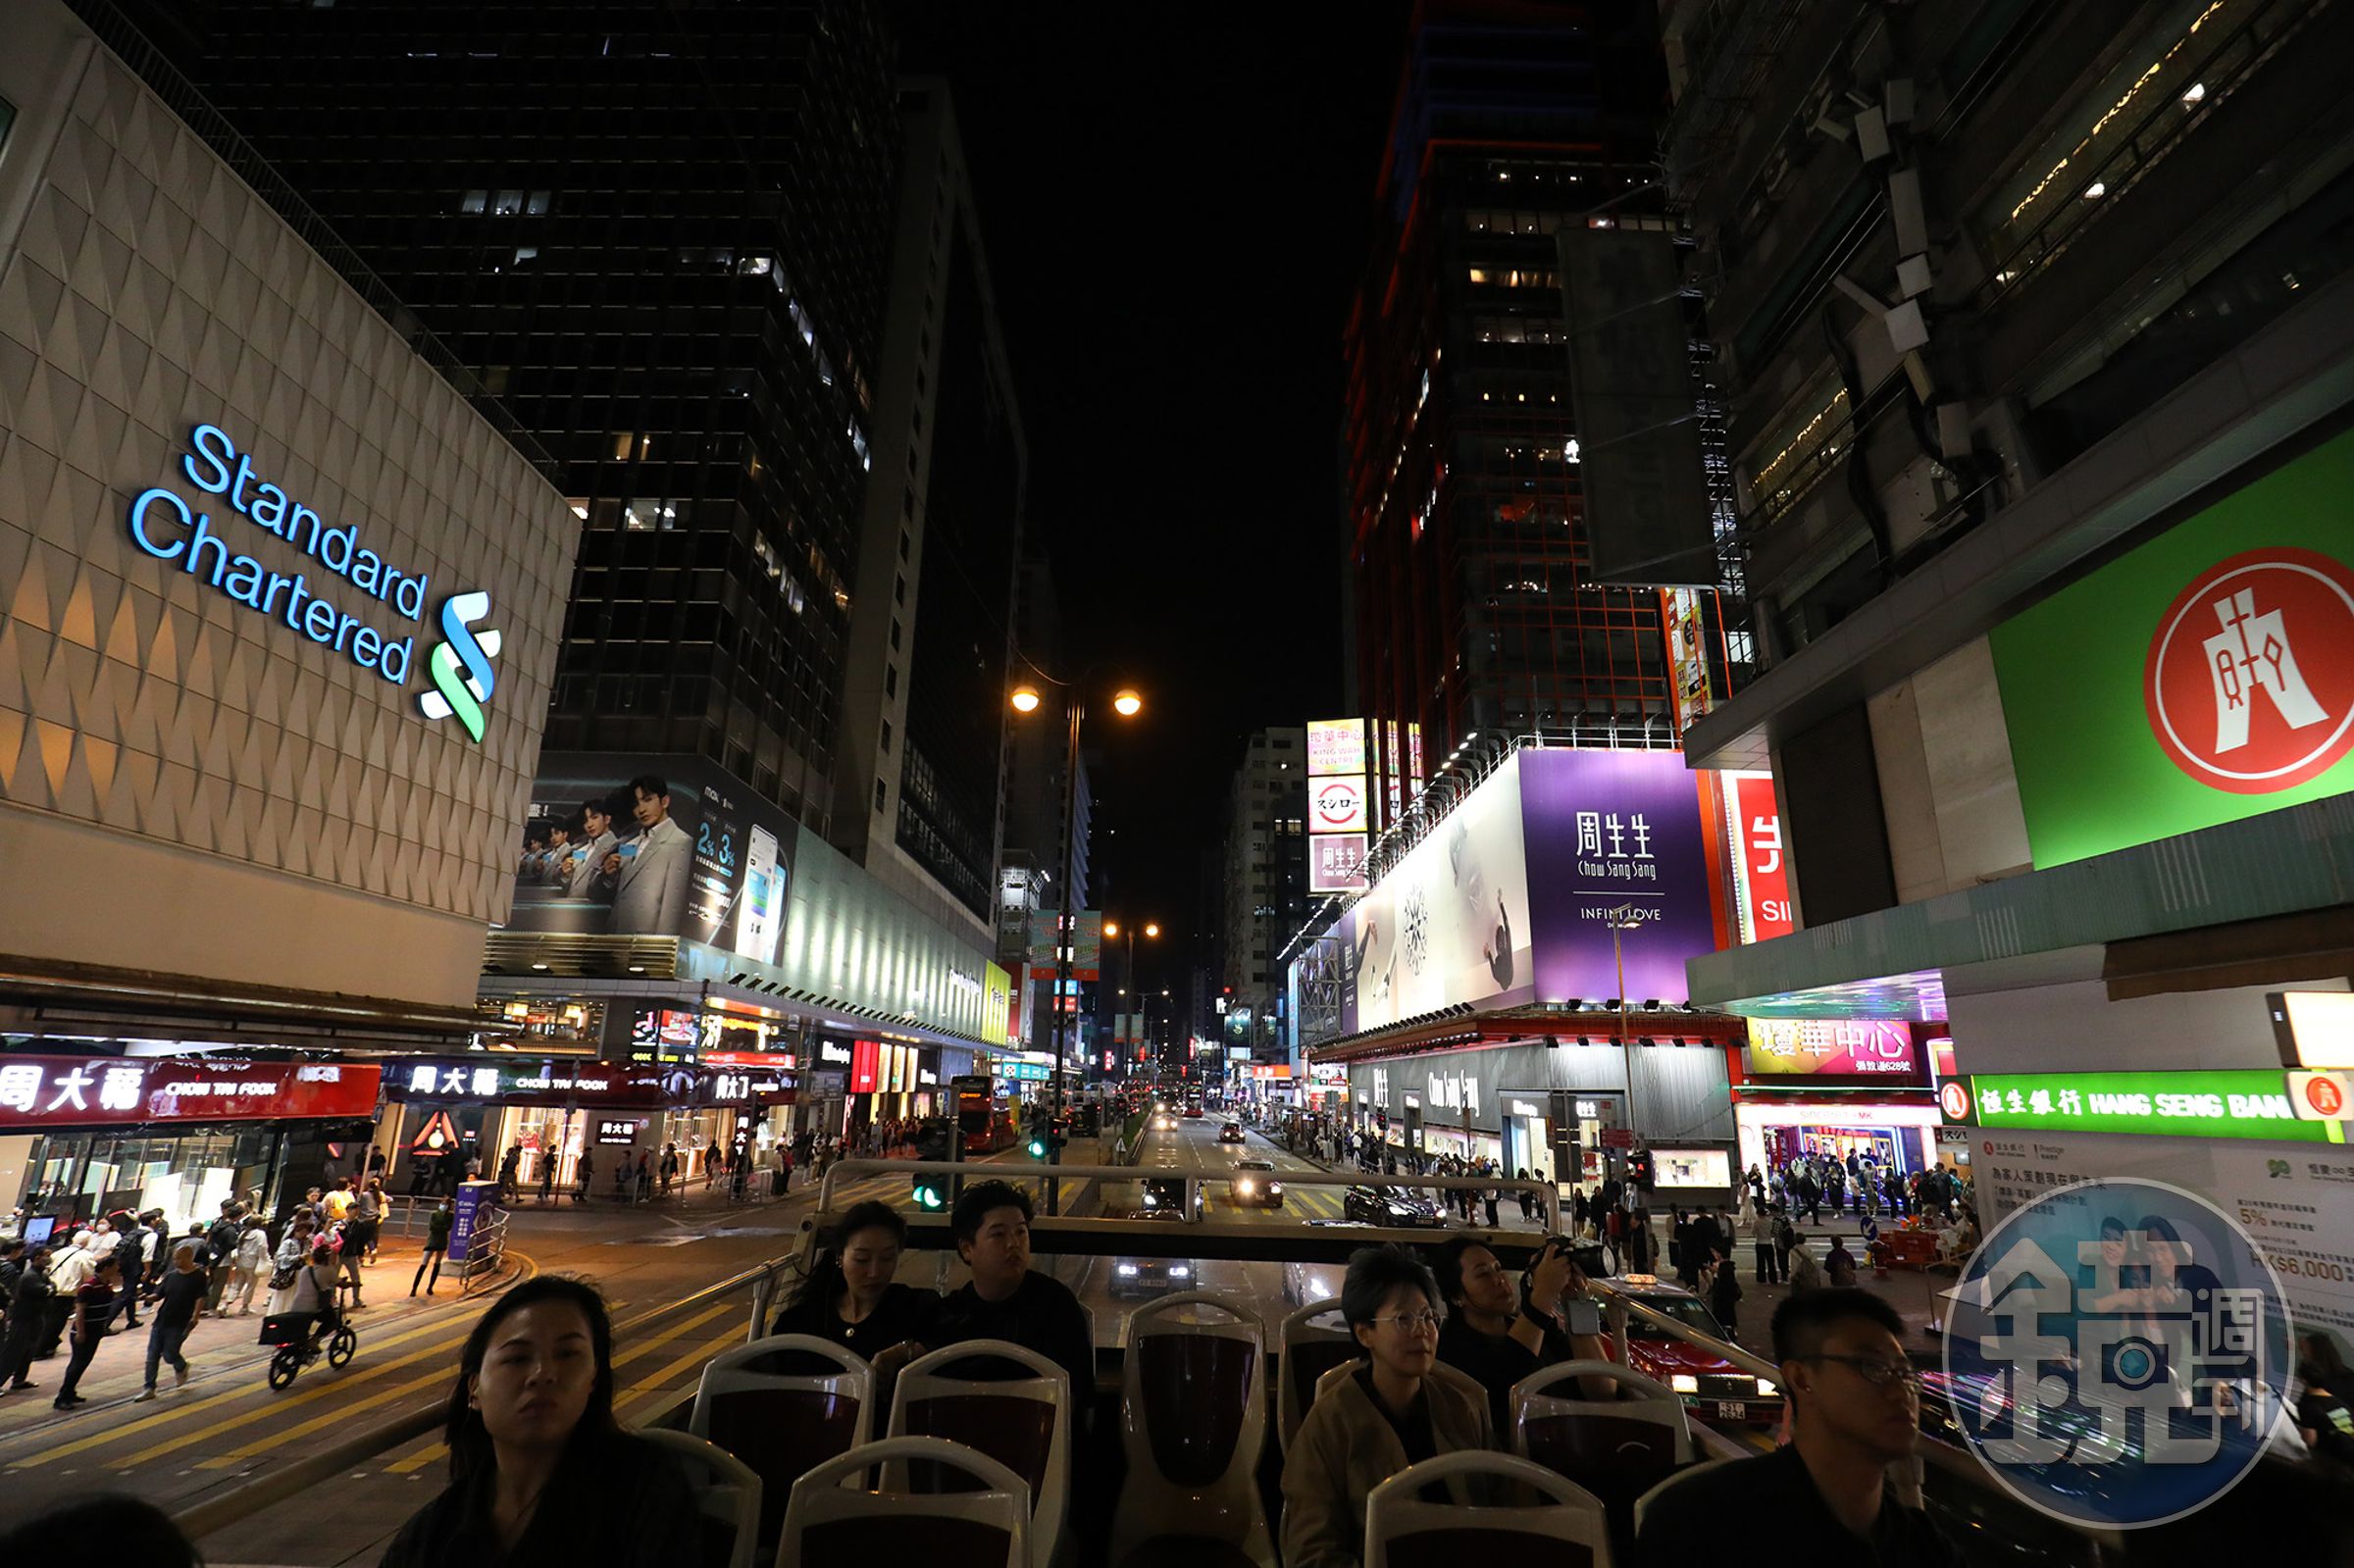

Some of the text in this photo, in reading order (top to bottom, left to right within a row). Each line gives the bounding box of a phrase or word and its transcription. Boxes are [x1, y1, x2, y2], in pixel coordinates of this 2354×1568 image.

[183, 423, 428, 622] Standard
[130, 487, 414, 685] Chartered
[1317, 798, 1360, 810] スシロー
[1576, 811, 1655, 859] 周生生
[1322, 847, 1356, 869] 周生生
[1578, 860, 1657, 881] Chow Sang Sang
[1759, 1020, 1906, 1058] 瓊華中心
[0, 1065, 277, 1113] 周大福 CHOW TAI FOOK
[409, 1065, 500, 1096] 周大福
[516, 1078, 550, 1089] CHOW
[551, 1079, 572, 1089] TAI
[1980, 1087, 2081, 1117] 恒生銀行
[2088, 1093, 2153, 1116] HANG
[2156, 1093, 2225, 1118] SENG
[2239, 1207, 2268, 1227] 5%
